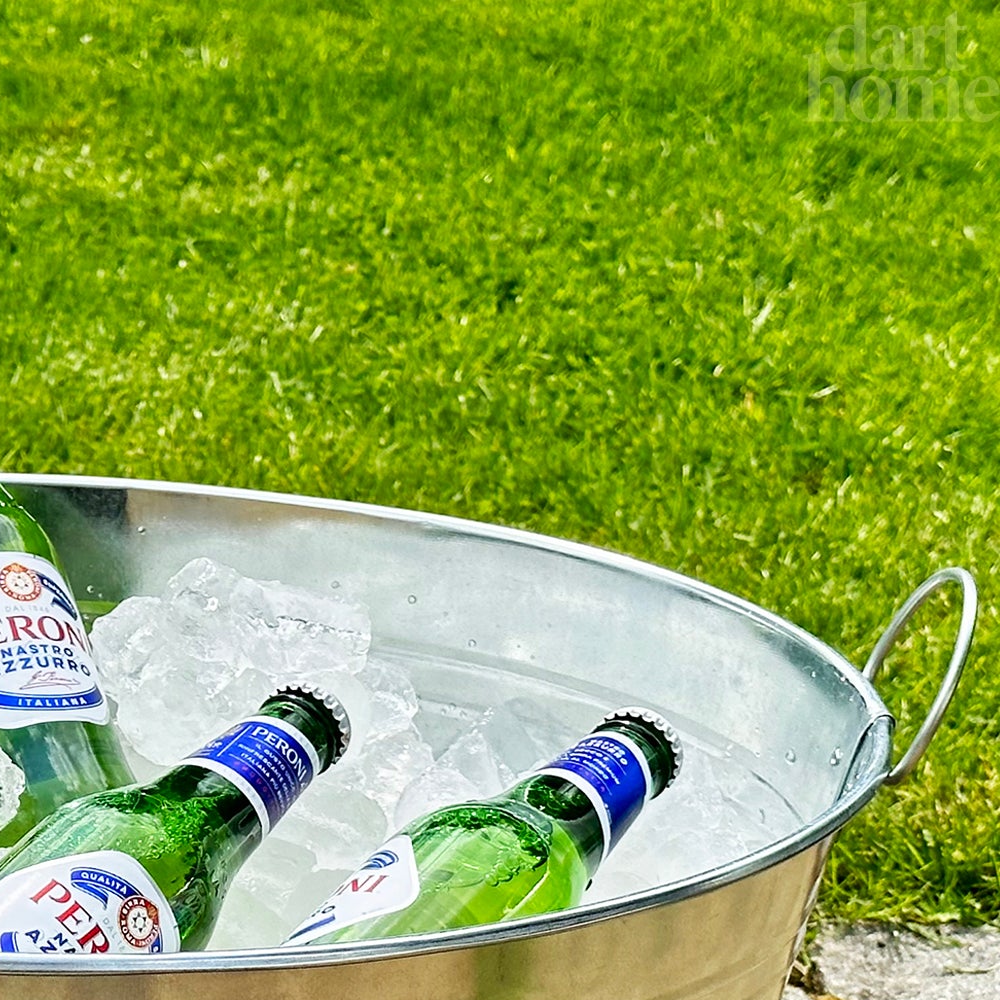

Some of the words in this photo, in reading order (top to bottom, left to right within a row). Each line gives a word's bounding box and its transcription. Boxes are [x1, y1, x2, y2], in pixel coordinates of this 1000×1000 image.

[0, 643, 74, 658] NASTRO
[18, 696, 88, 707] ITALIANA
[251, 726, 307, 782] PERONI
